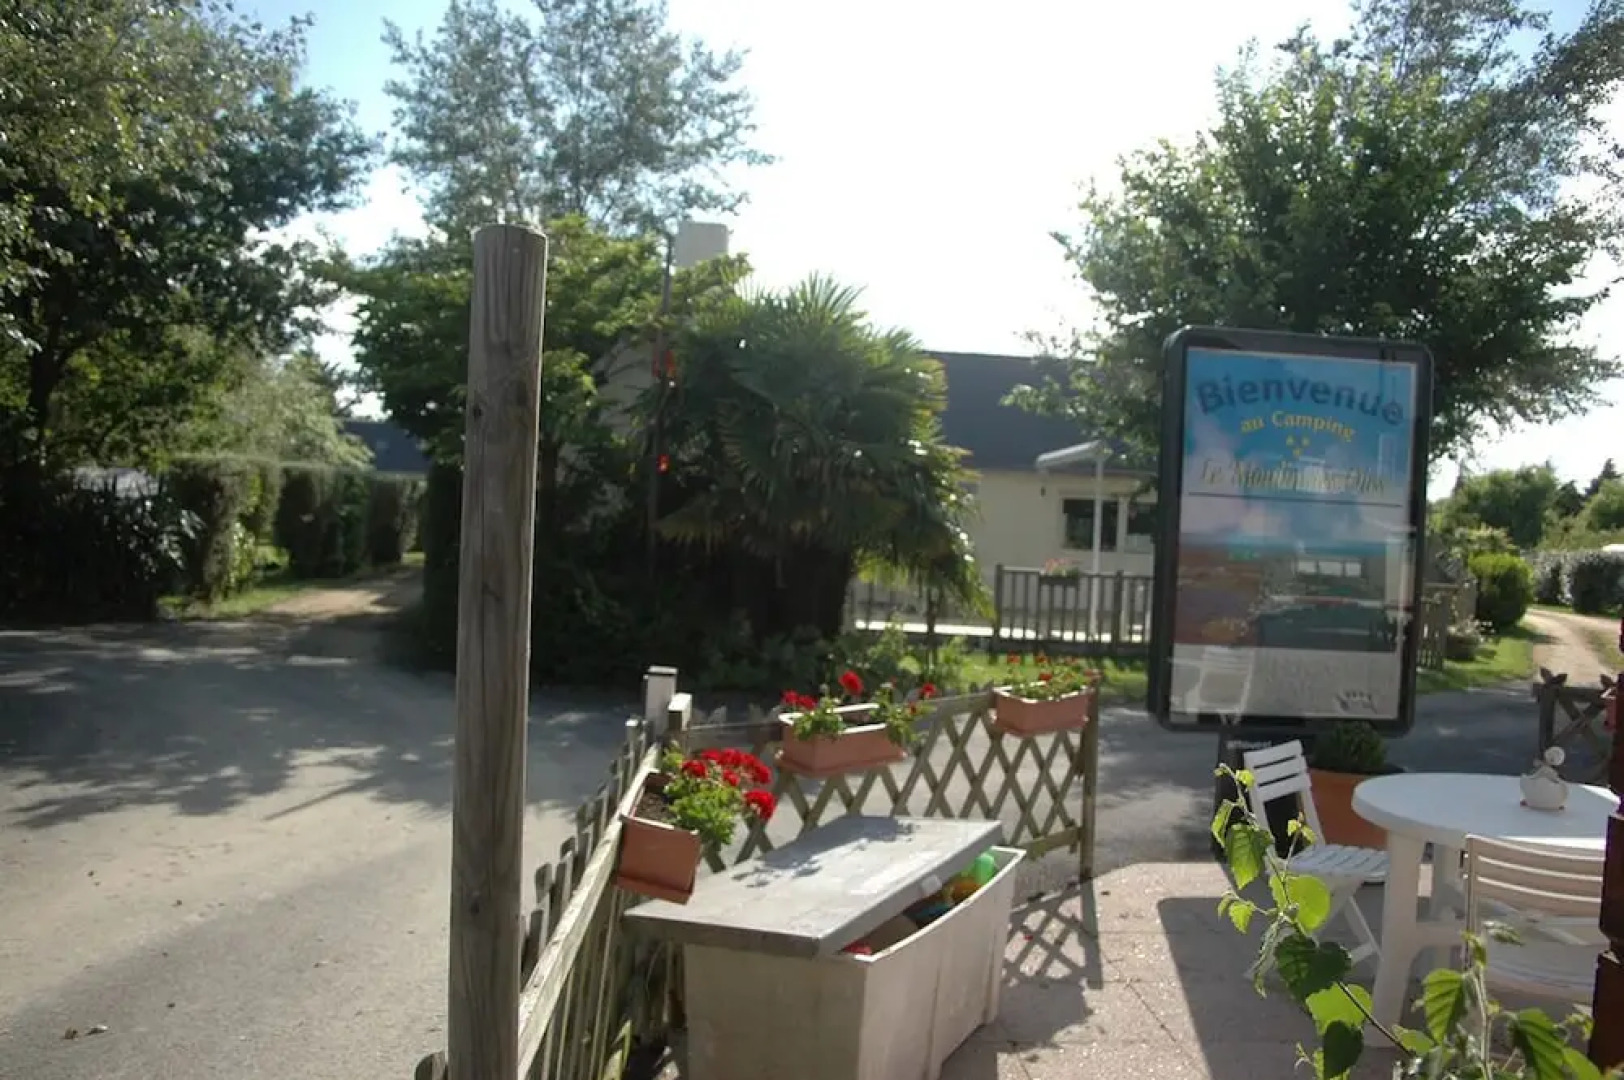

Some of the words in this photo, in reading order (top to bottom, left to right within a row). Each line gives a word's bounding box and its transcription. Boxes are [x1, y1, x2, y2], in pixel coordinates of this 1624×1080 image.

[1196, 374, 1405, 426] Bienvenue
[1241, 414, 1265, 433] au
[1271, 410, 1356, 442] Camping
